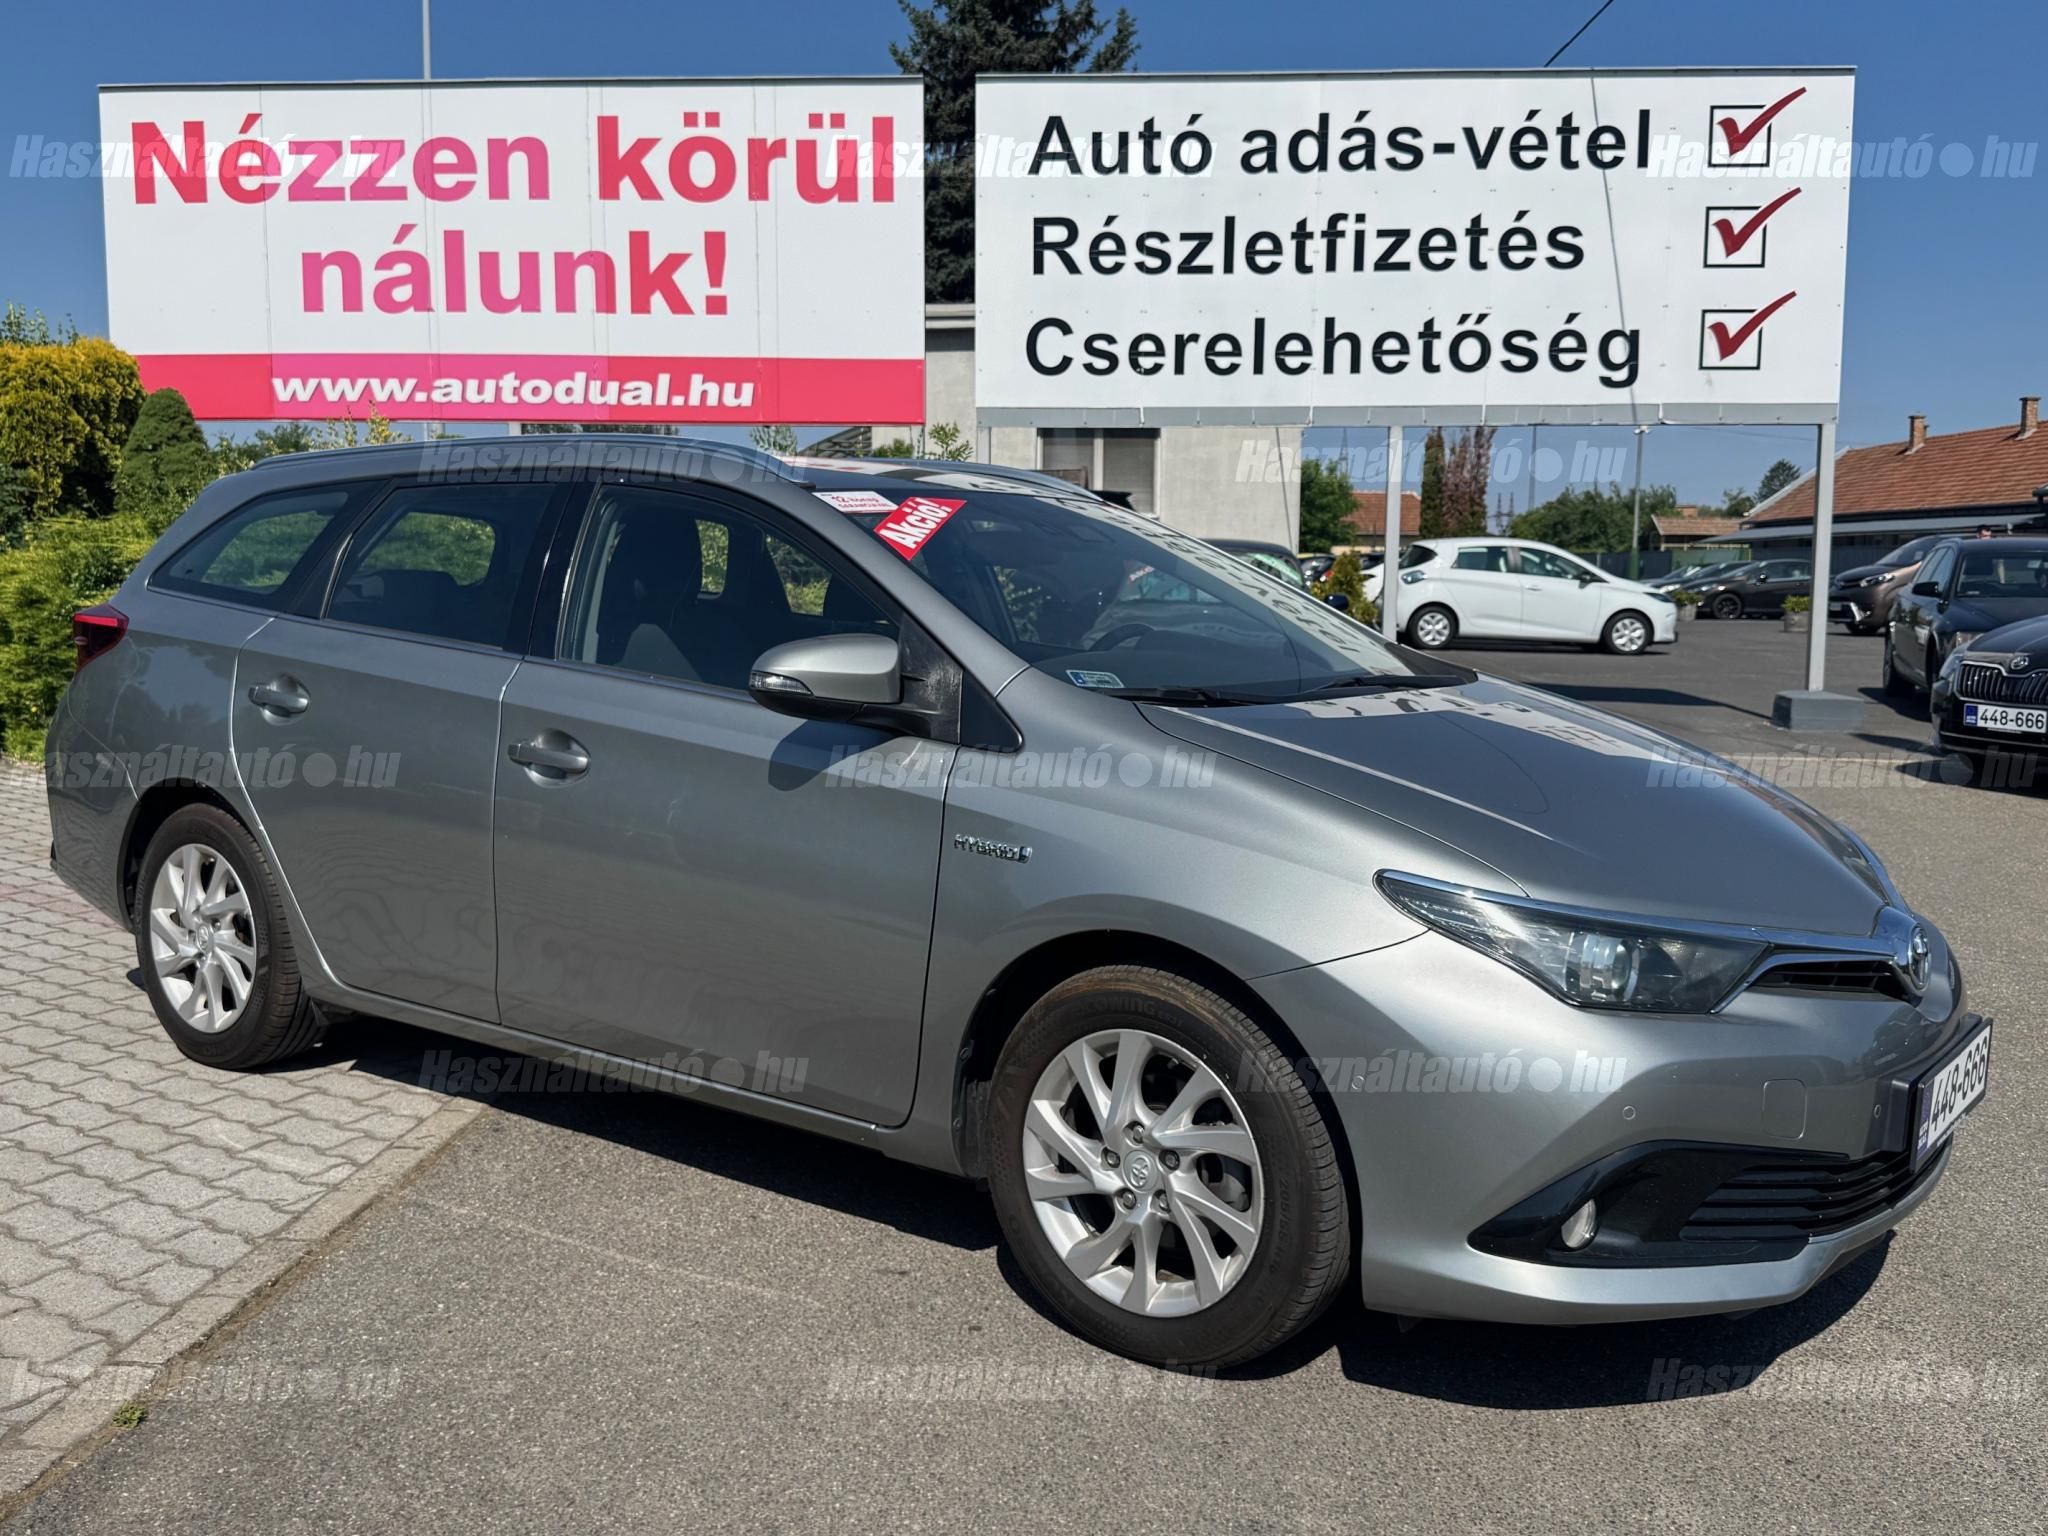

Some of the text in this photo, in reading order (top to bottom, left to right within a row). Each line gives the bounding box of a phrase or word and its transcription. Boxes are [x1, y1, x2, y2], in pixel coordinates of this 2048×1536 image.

[131, 111, 895, 204] Nézzen körül
[1028, 109, 1651, 175] Autó adás-vétel
[301, 224, 728, 316] nálunk!
[1032, 210, 1585, 275] Részletfizetés
[1026, 312, 1640, 388] Cserelehetőség
[272, 371, 754, 407] www.autodual.hu
[879, 497, 953, 549] Akció!
[1979, 708, 2045, 730] 448-666
[1930, 1035, 1989, 1132] 448-666
